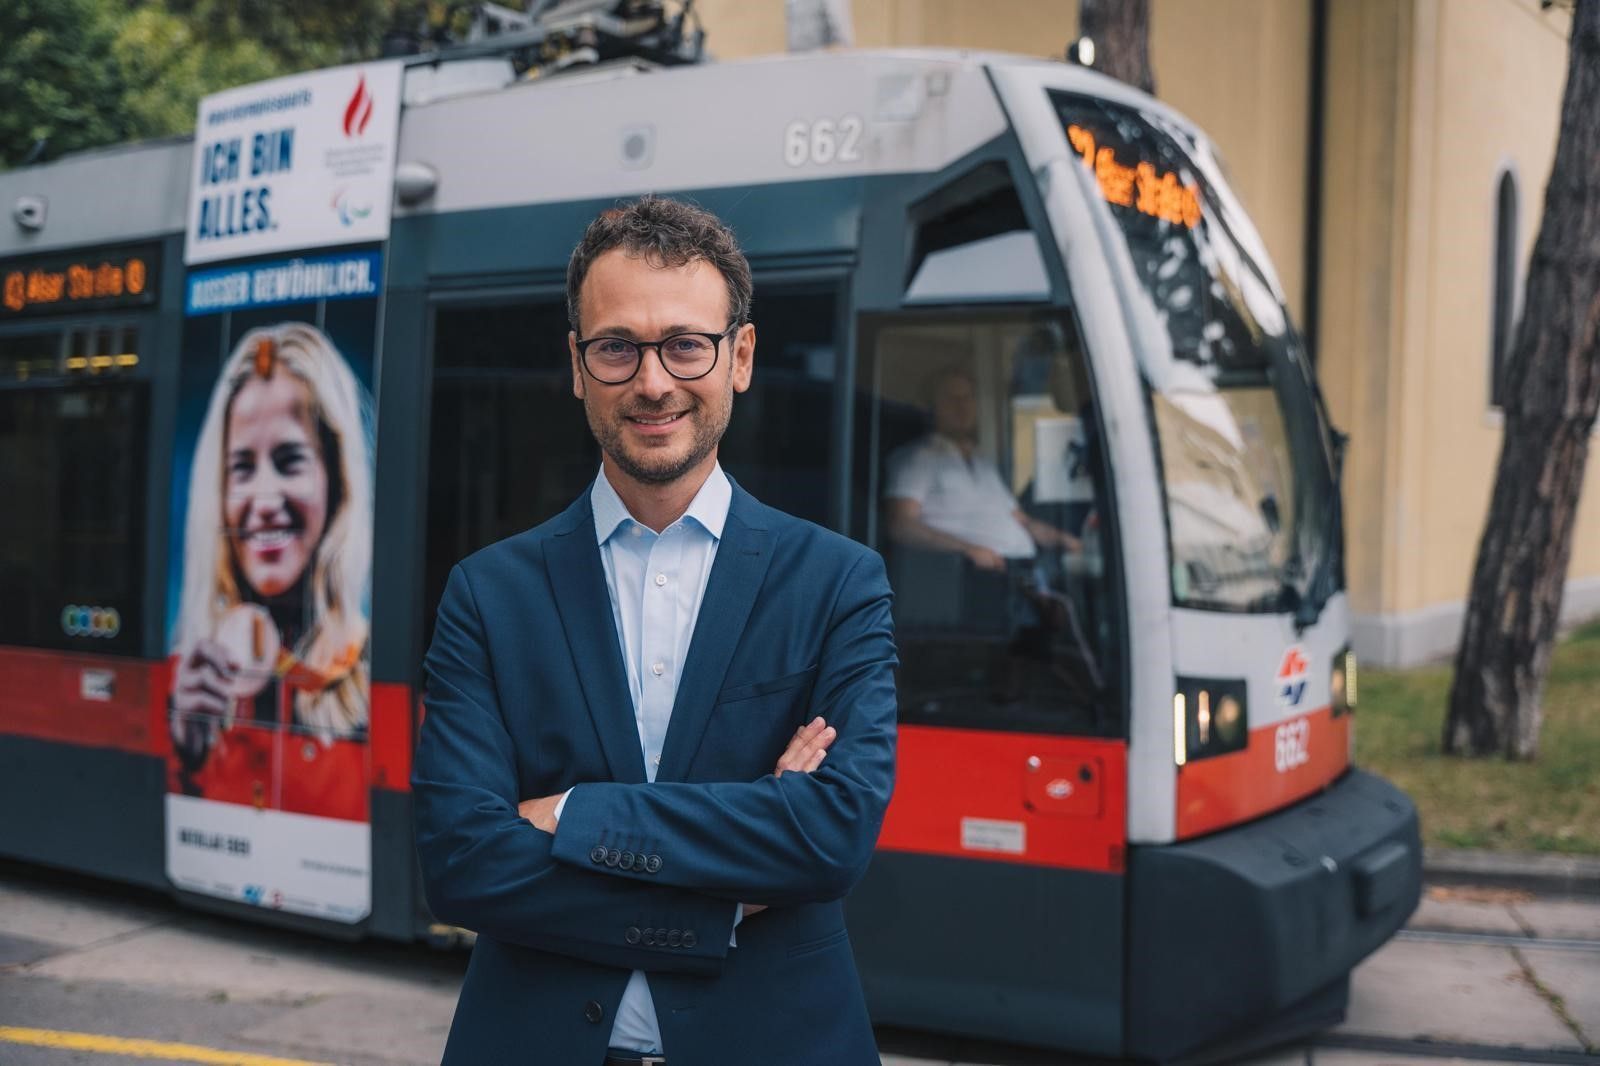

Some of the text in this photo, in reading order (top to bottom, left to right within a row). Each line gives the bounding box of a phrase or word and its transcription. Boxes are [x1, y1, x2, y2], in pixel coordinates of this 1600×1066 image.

[203, 139, 243, 186] ICH
[250, 127, 295, 176] BIN
[785, 117, 863, 167] 662
[197, 187, 279, 240] ALLES.
[1275, 717, 1310, 773] 662
